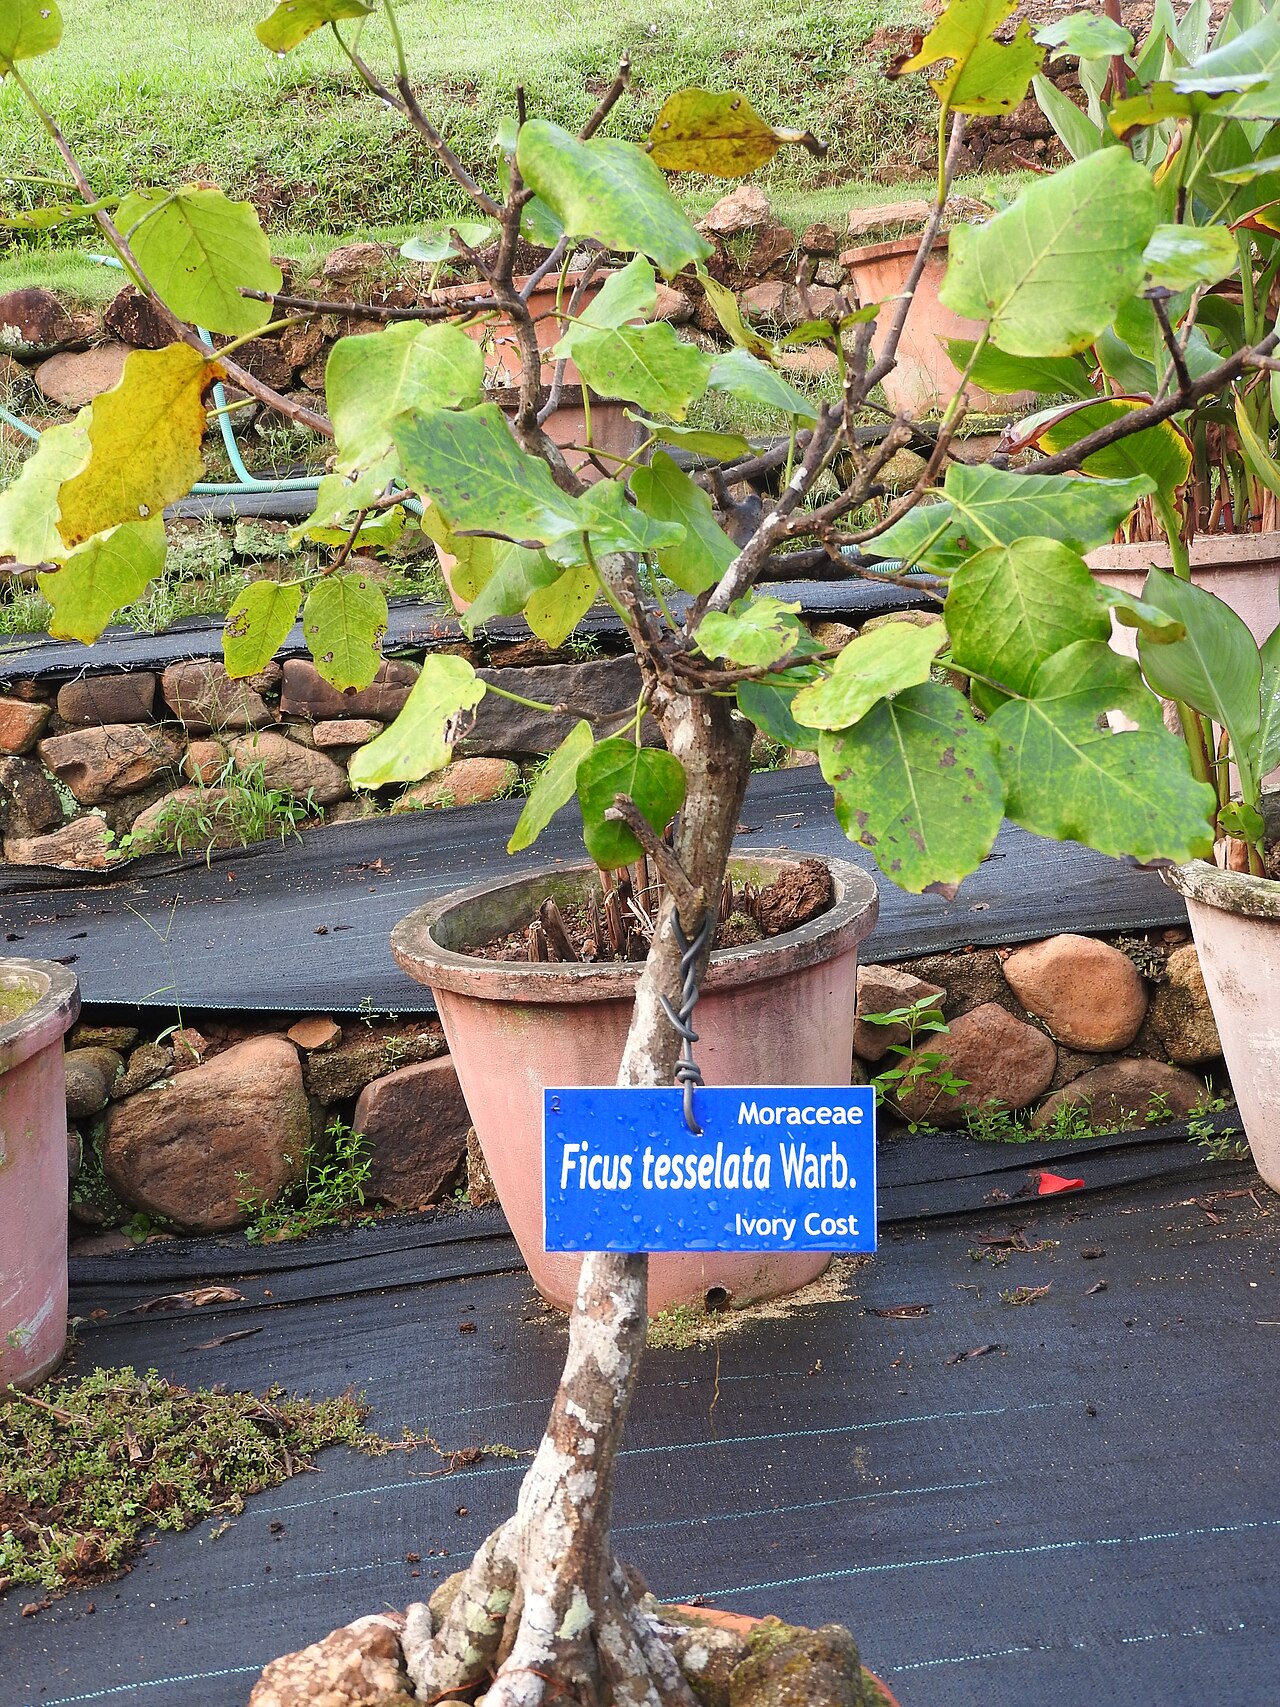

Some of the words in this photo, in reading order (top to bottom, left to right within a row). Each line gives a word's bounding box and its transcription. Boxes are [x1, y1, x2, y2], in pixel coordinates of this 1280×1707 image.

[737, 1101, 864, 1126] Moraceae
[560, 1140, 633, 1190] Ficus
[641, 1140, 771, 1190] tesselata
[779, 1141, 858, 1190] Warb.
[735, 1213, 797, 1241] Ivory
[804, 1212, 860, 1236] Cost
